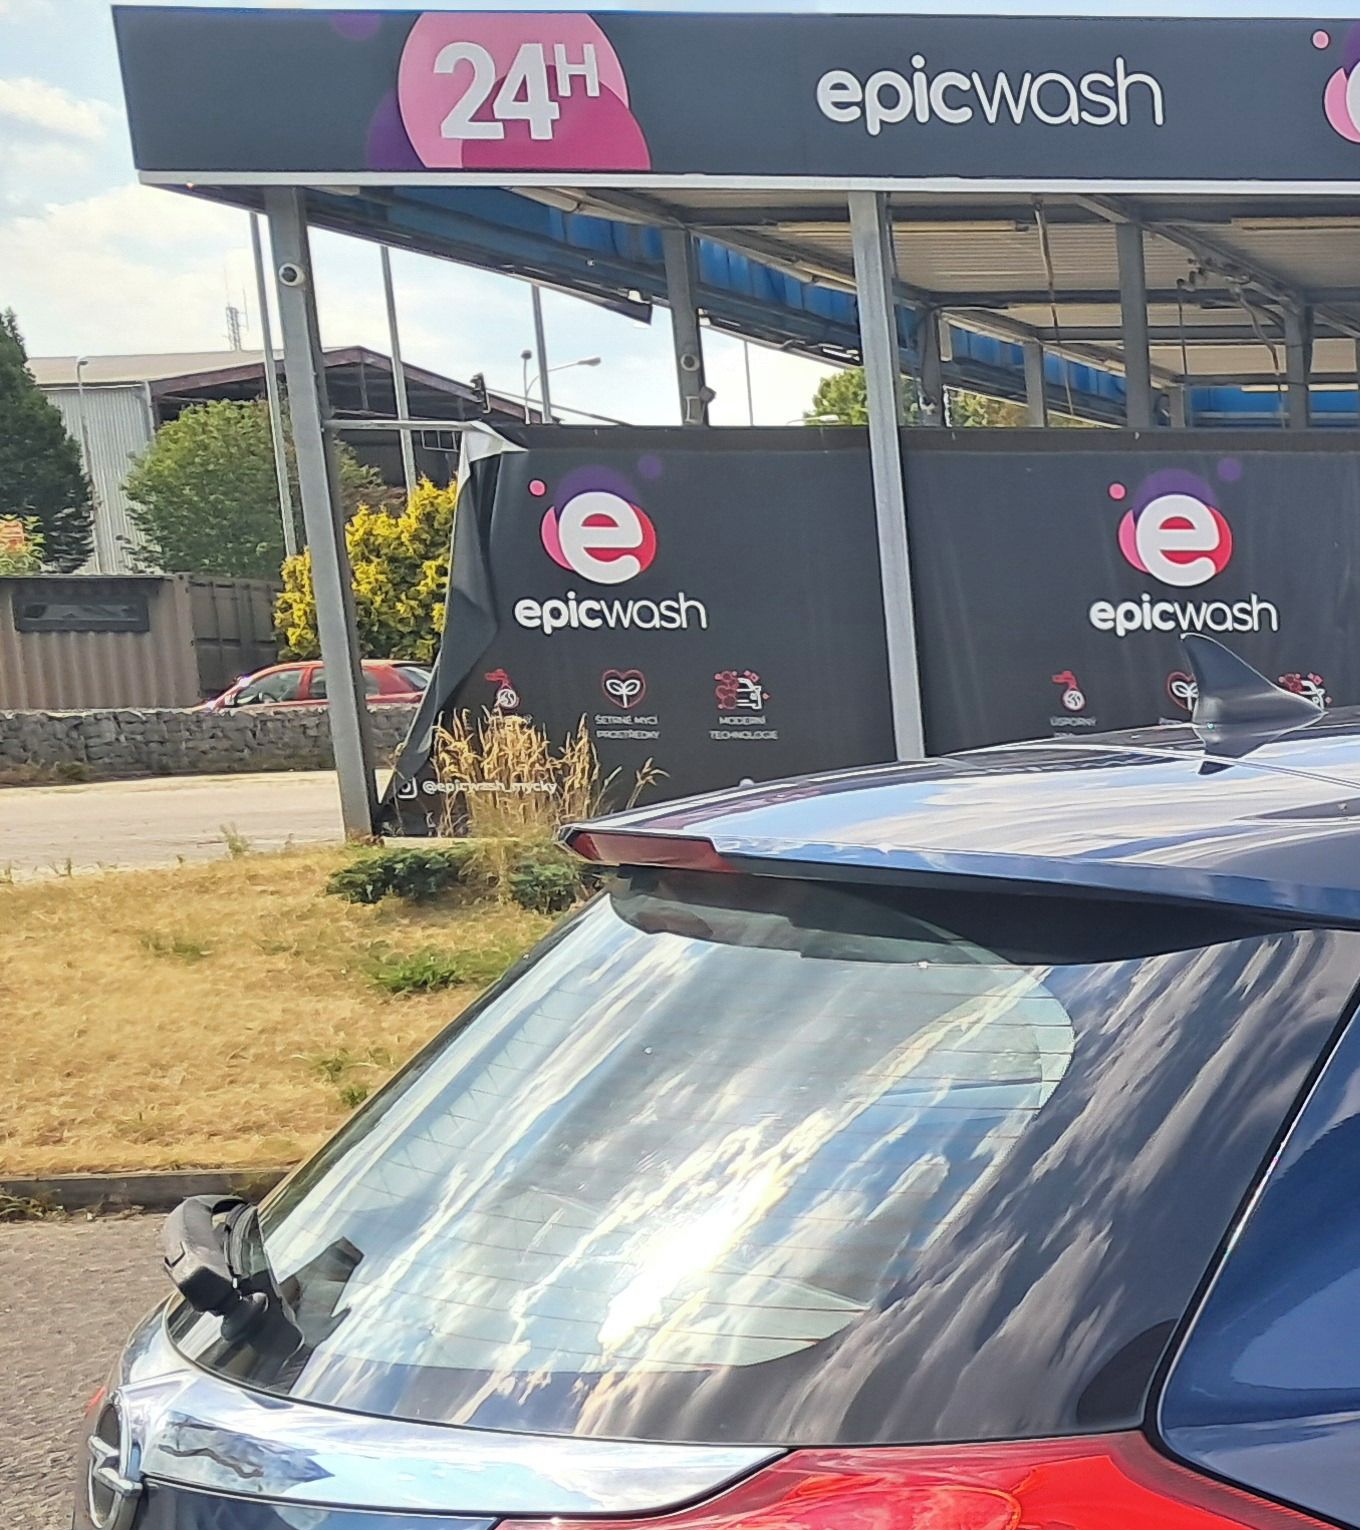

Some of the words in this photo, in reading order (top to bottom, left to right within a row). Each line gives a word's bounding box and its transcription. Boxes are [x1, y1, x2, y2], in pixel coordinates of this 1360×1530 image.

[817, 55, 1165, 135] epicwash
[514, 592, 707, 635] epicwash
[1089, 593, 1278, 636] epicwash
[709, 730, 778, 740] TECHNOLOGIE
